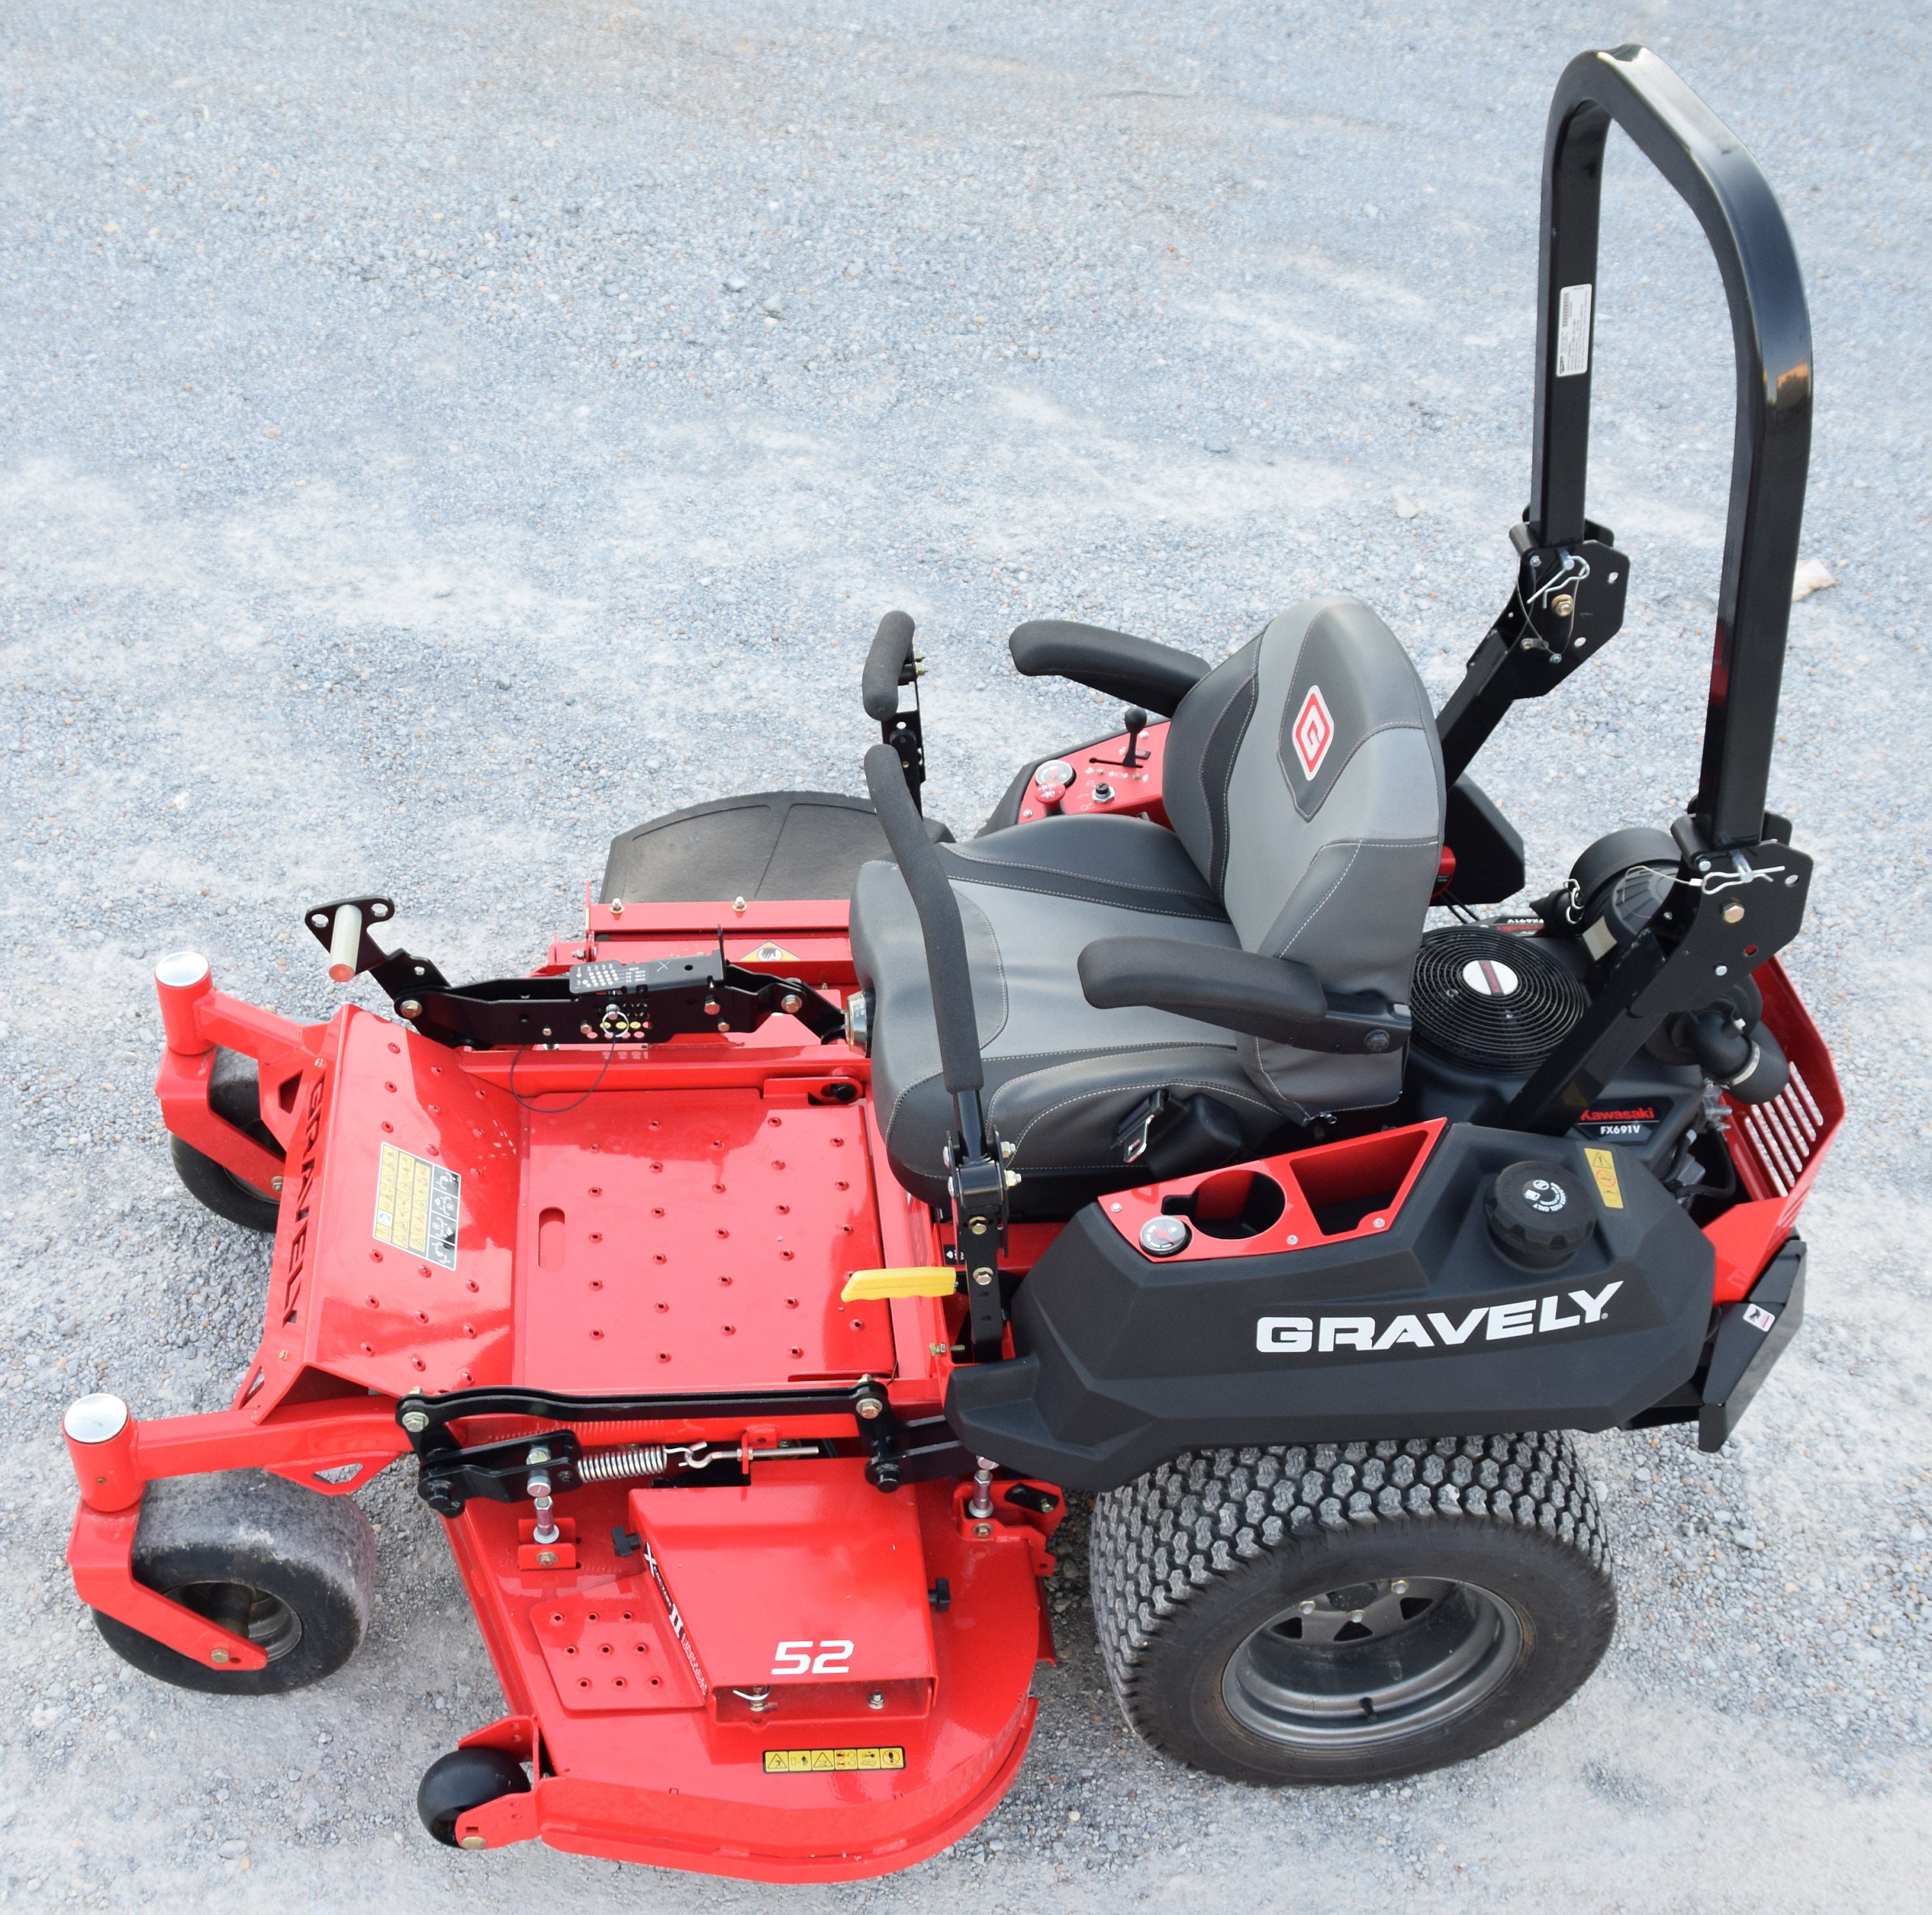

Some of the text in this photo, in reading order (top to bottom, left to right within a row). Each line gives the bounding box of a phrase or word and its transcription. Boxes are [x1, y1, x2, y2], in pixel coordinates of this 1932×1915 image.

[1600, 1125, 1641, 1135] FX691V
[283, 1072, 326, 1328] GRAVELY
[1256, 1281, 1624, 1353] GRAVELY
[771, 1639, 855, 1675] 52
